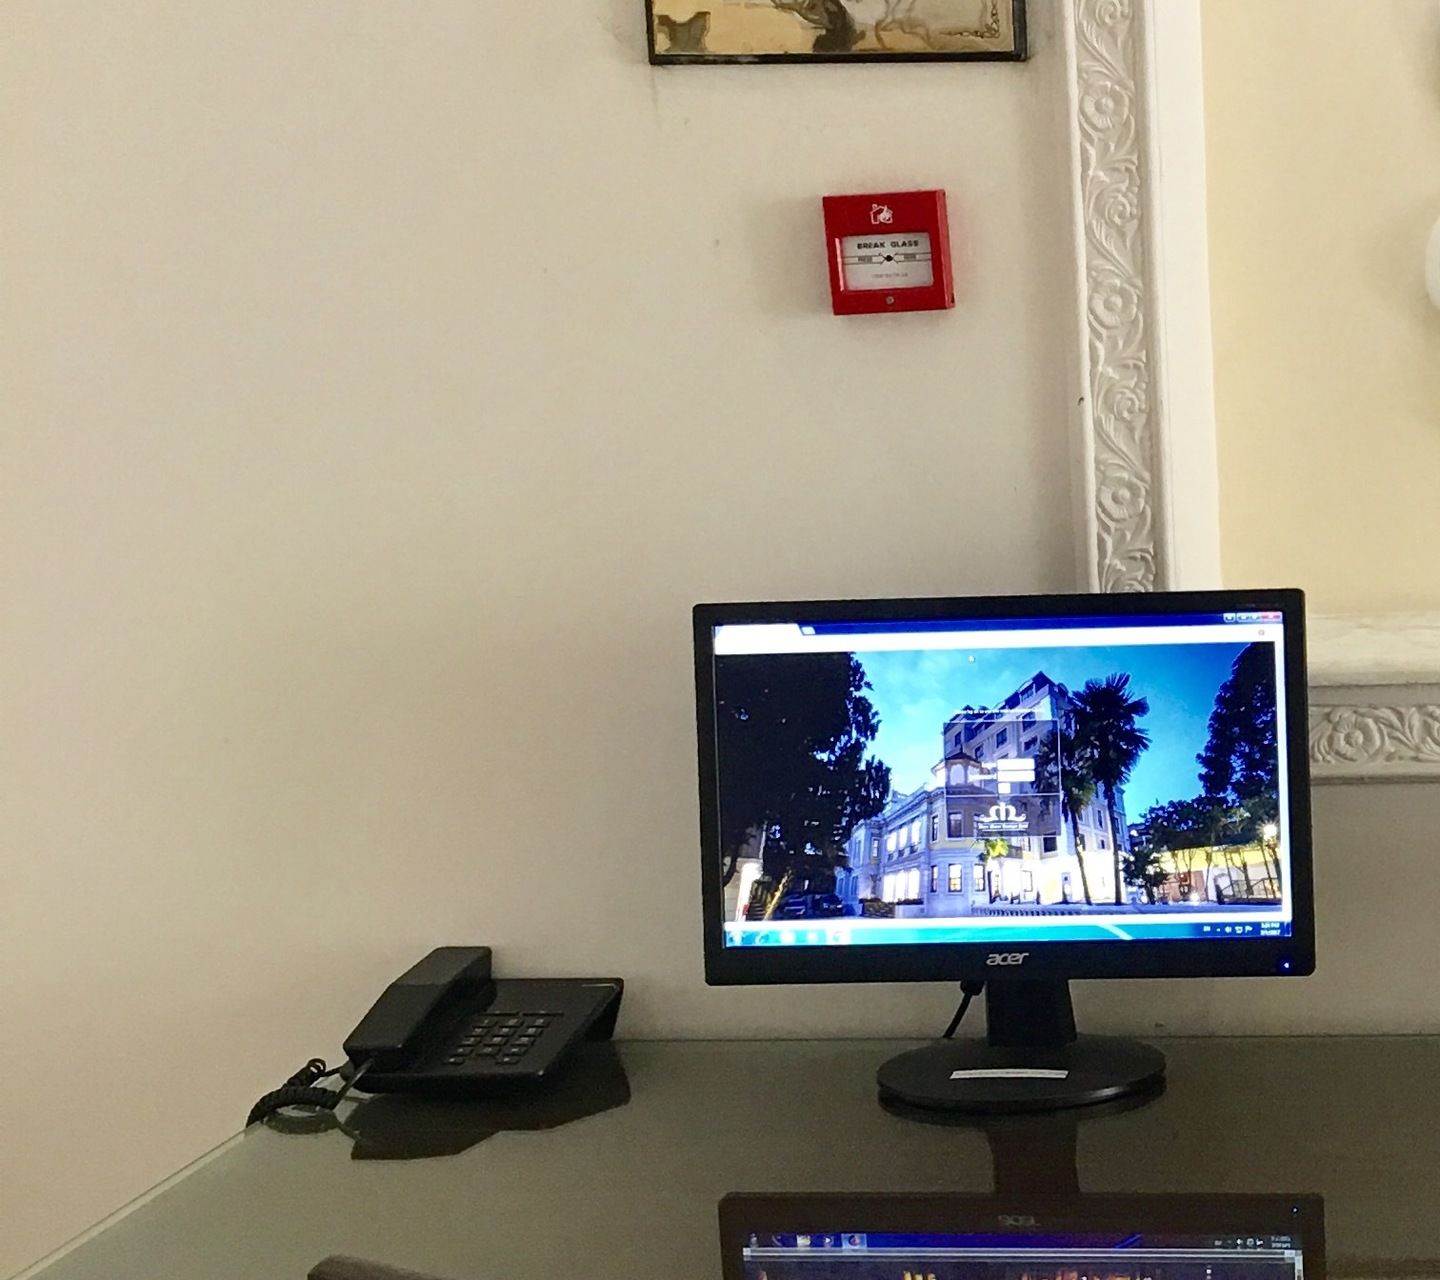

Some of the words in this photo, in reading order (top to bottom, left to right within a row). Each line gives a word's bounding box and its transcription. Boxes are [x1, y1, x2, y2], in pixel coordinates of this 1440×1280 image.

[857, 241, 886, 250] BREAK
[890, 239, 919, 248] GLASS
[986, 952, 1030, 966] acer
